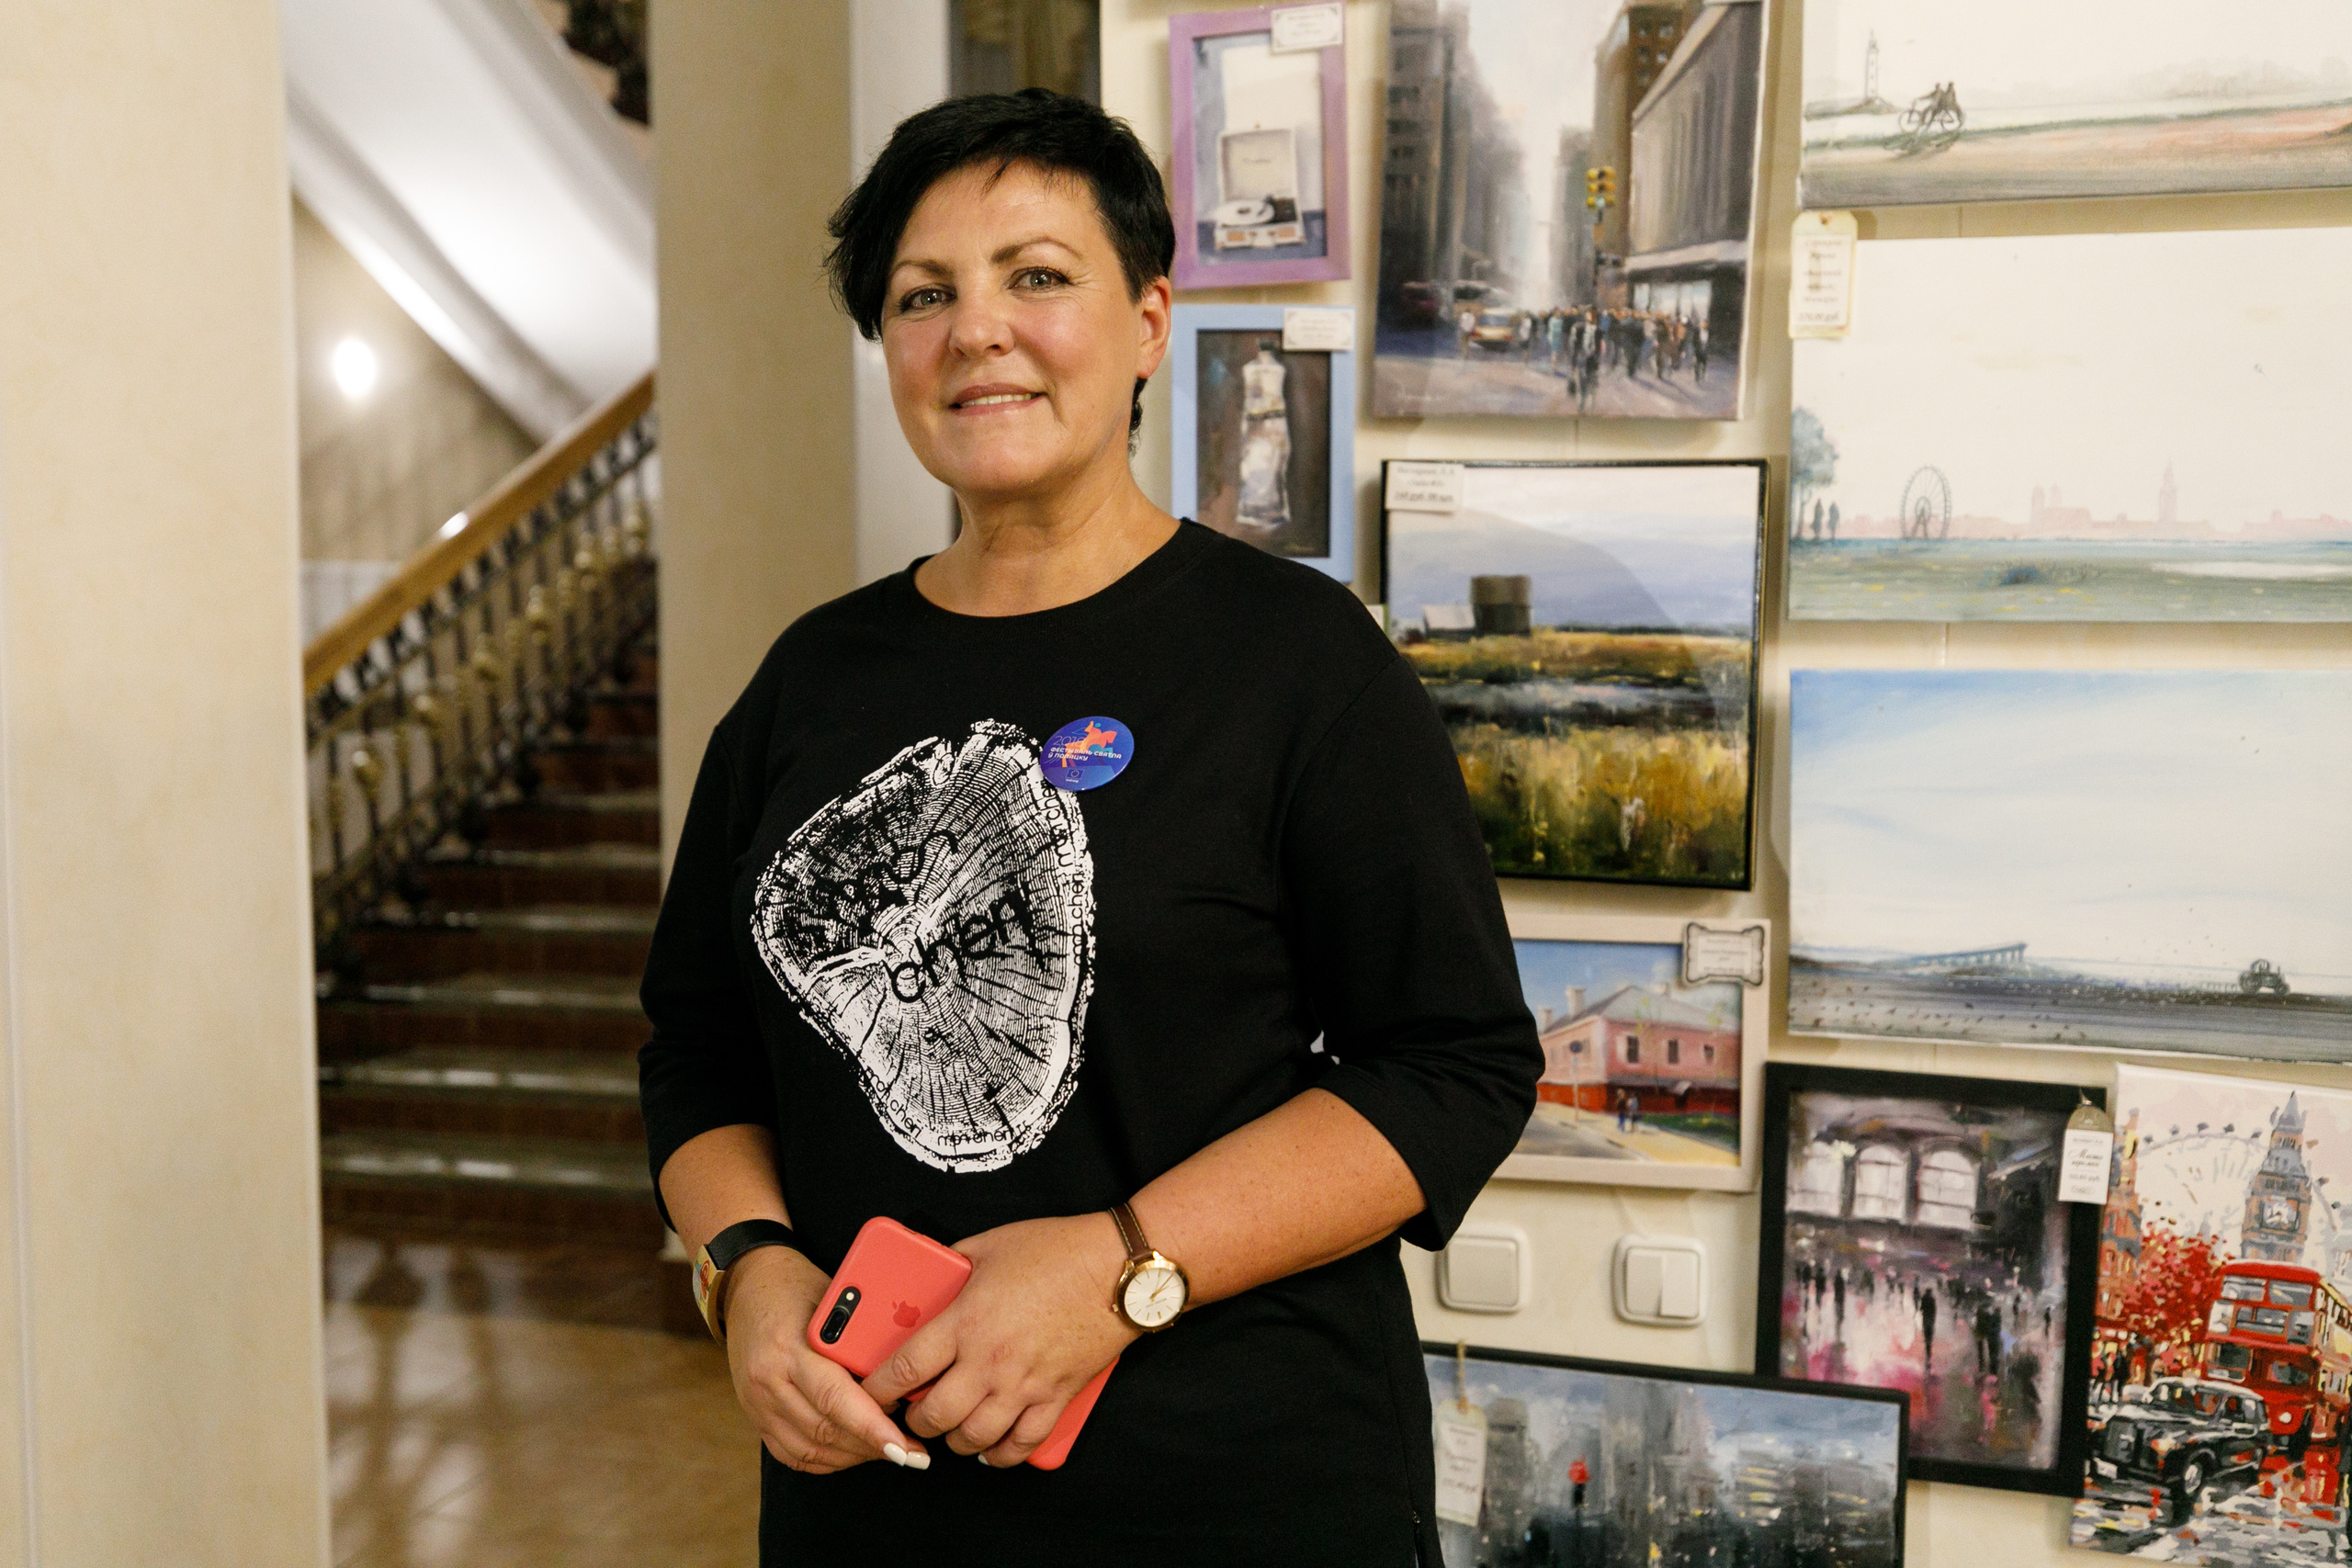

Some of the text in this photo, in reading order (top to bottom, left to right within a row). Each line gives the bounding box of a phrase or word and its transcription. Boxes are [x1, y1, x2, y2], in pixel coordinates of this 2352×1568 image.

[1050, 747, 1122, 760] ФЕСТЫВАЛЬ СВЯТЛА
[1055, 752, 1089, 761] ПОЛАЦКУ
